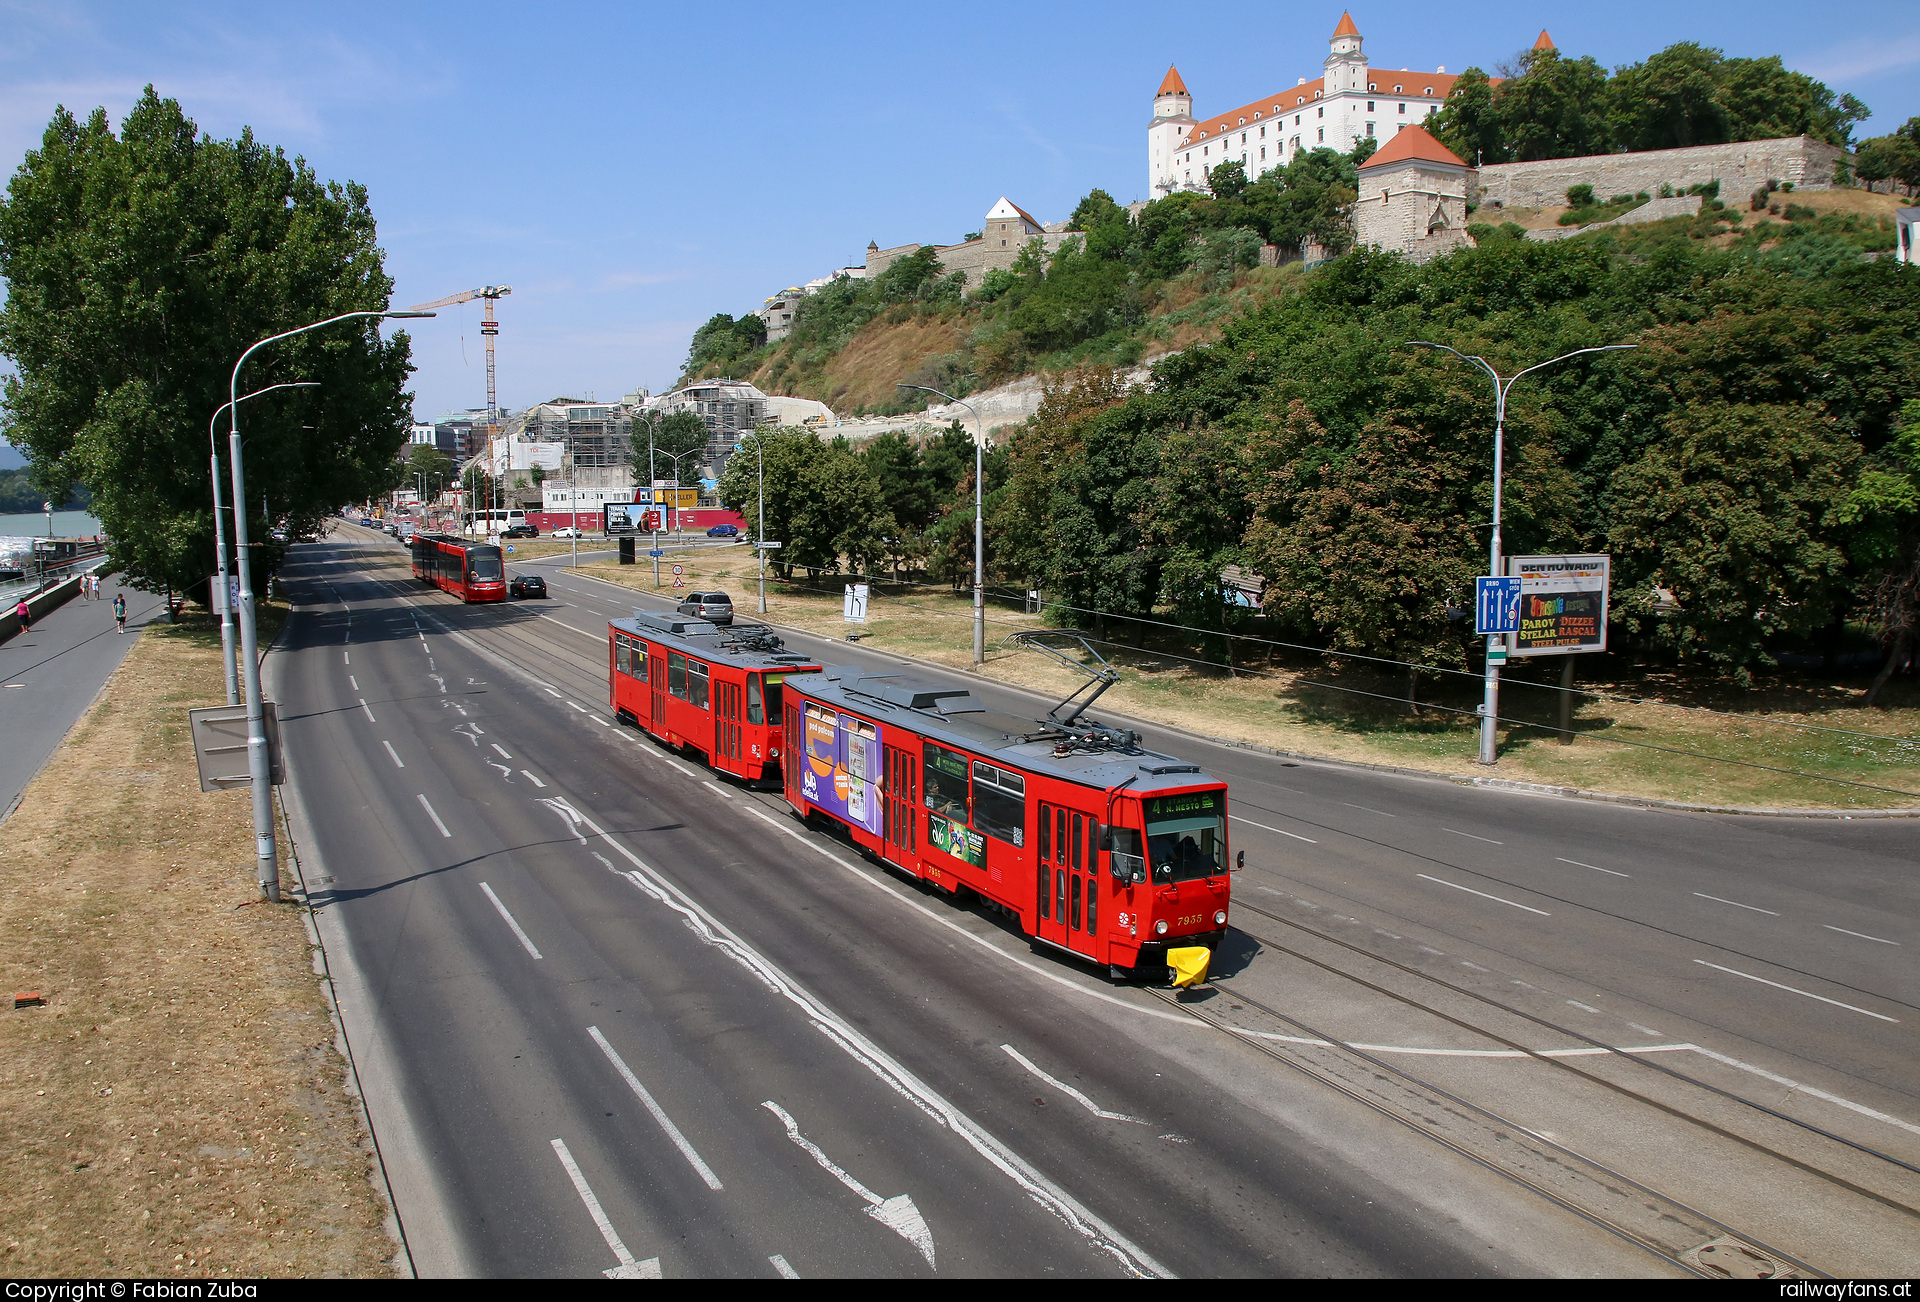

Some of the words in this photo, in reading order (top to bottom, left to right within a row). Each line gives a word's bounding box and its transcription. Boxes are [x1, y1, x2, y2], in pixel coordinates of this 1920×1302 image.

[1522, 619, 1555, 629] PAROV
[1561, 617, 1594, 626] DIZZEE
[1520, 629, 1557, 639] STELAR
[1559, 627, 1596, 636] RASCAL
[1532, 640, 1555, 648] STEEL
[1152, 800, 1160, 813] 4
[1177, 914, 1202, 926] 7935
